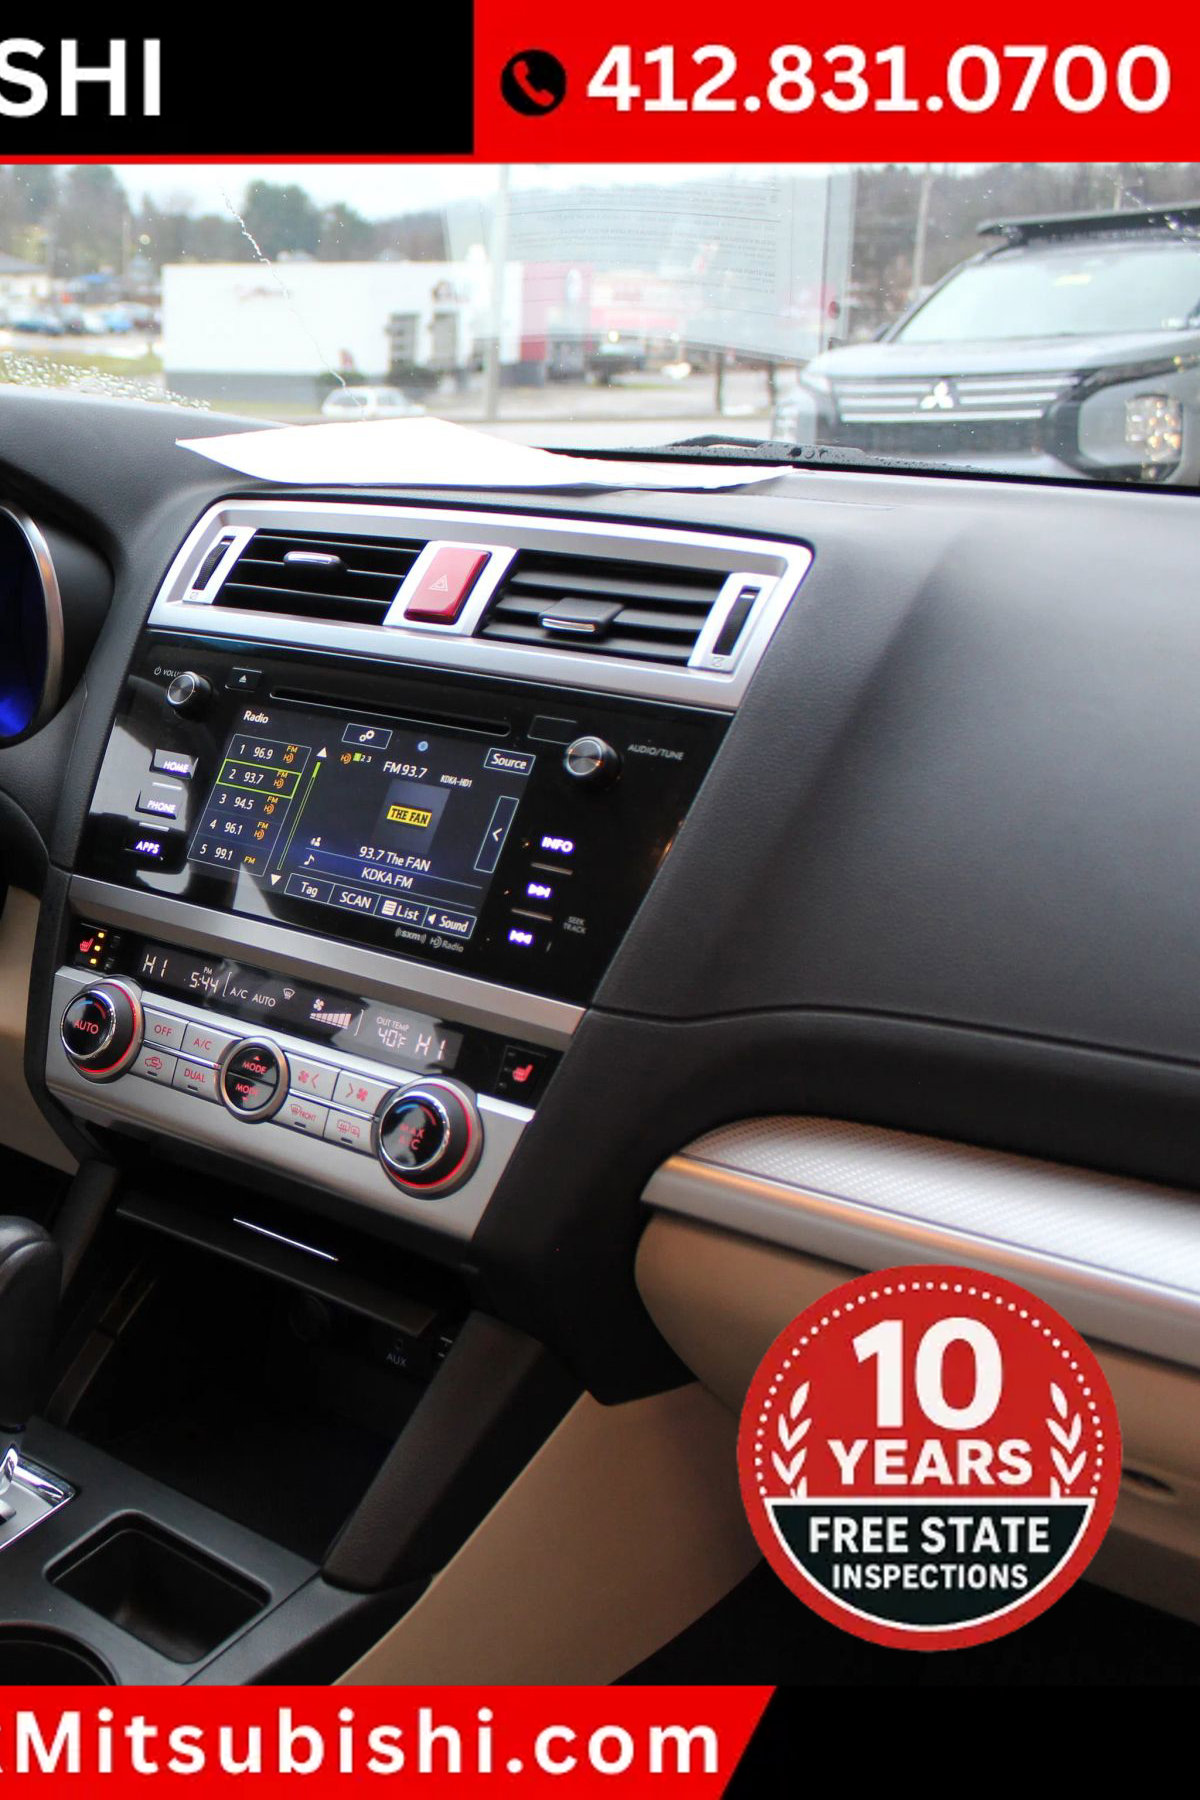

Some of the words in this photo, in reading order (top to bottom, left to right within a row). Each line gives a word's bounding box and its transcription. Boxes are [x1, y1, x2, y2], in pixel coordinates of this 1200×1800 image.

[243, 710, 269, 724] Radio
[240, 744, 246, 755] 1
[253, 746, 274, 760] 96.9
[286, 745, 298, 753] FM
[627, 743, 685, 761] AUDIO/TUNE
[163, 760, 189, 773] HOME
[490, 753, 527, 770] Source
[229, 768, 235, 780] 2
[243, 771, 264, 785] 93.7
[276, 771, 288, 779] FM
[383, 761, 401, 774] FM
[402, 764, 428, 779] 93.7
[440, 774, 473, 788] KDKA-HD1
[147, 800, 177, 813] PHONE
[219, 794, 226, 804] 3
[233, 797, 255, 811] 94.5
[266, 796, 279, 804] FM
[390, 808, 407, 821] THE
[409, 810, 429, 825] FAN
[209, 819, 217, 830] 4
[224, 822, 243, 835] 96.1
[257, 821, 269, 829] FM
[136, 840, 160, 854] APPS
[541, 836, 574, 853] INFO
[200, 844, 208, 855] 5
[214, 847, 233, 861] 99.1
[244, 856, 256, 865] FM
[359, 846, 385, 861] 93.7
[386, 852, 405, 866] The
[405, 856, 431, 872] FAN
[361, 867, 393, 885] KDKA
[394, 874, 414, 890] FM
[301, 881, 319, 898] Tag
[339, 891, 372, 909] SCAN
[396, 905, 420, 921] List
[439, 915, 469, 933] Sound
[442, 940, 464, 953] Radio
[203, 966, 213, 975] PM
[189, 971, 220, 994] 5:44
[229, 988, 249, 1000] A/C
[252, 993, 276, 1008] AUTO
[74, 1020, 99, 1035] AUTO
[376, 1016, 391, 1027] OUT
[154, 1024, 173, 1037] OFF
[193, 1038, 213, 1051] A/C
[242, 1060, 268, 1075] MODE
[184, 1068, 206, 1084] DUAL
[385, 1352, 407, 1368] AUX
